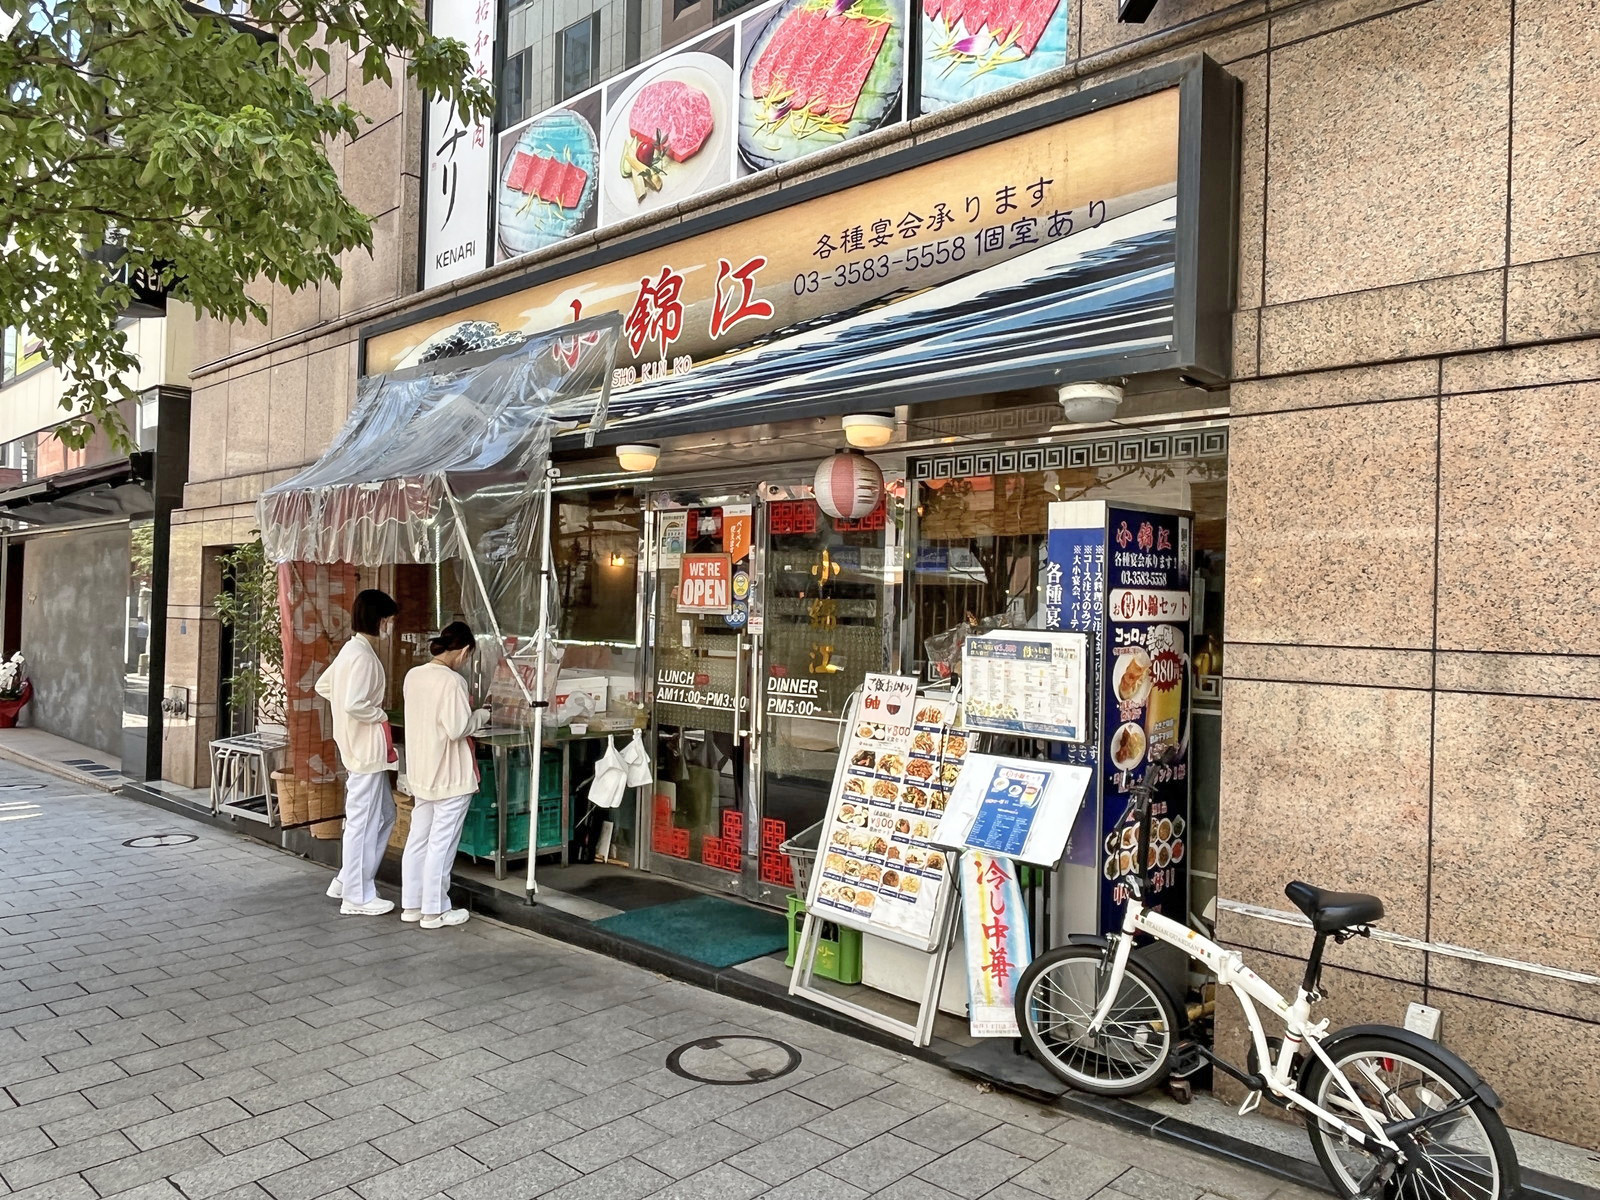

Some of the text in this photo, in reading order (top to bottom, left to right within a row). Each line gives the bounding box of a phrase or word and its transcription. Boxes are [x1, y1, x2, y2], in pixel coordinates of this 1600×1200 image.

[812, 176, 1054, 260] 各種宴会承ります
[436, 240, 475, 269] KENARI
[793, 200, 1107, 296] 03-3583-5558 個室あり
[551, 255, 775, 373] 小錦江
[612, 355, 692, 387] SHO KIN KO
[1116, 520, 1172, 553] 小錦江
[689, 562, 721, 577] WE'RE
[1121, 570, 1168, 586] 03-3583-5558
[682, 578, 726, 606] OPEN
[1045, 561, 1063, 631] 各種宴
[657, 669, 695, 685] LUNCH
[766, 676, 818, 695] DINNER
[974, 860, 1016, 987] 冷し中華
